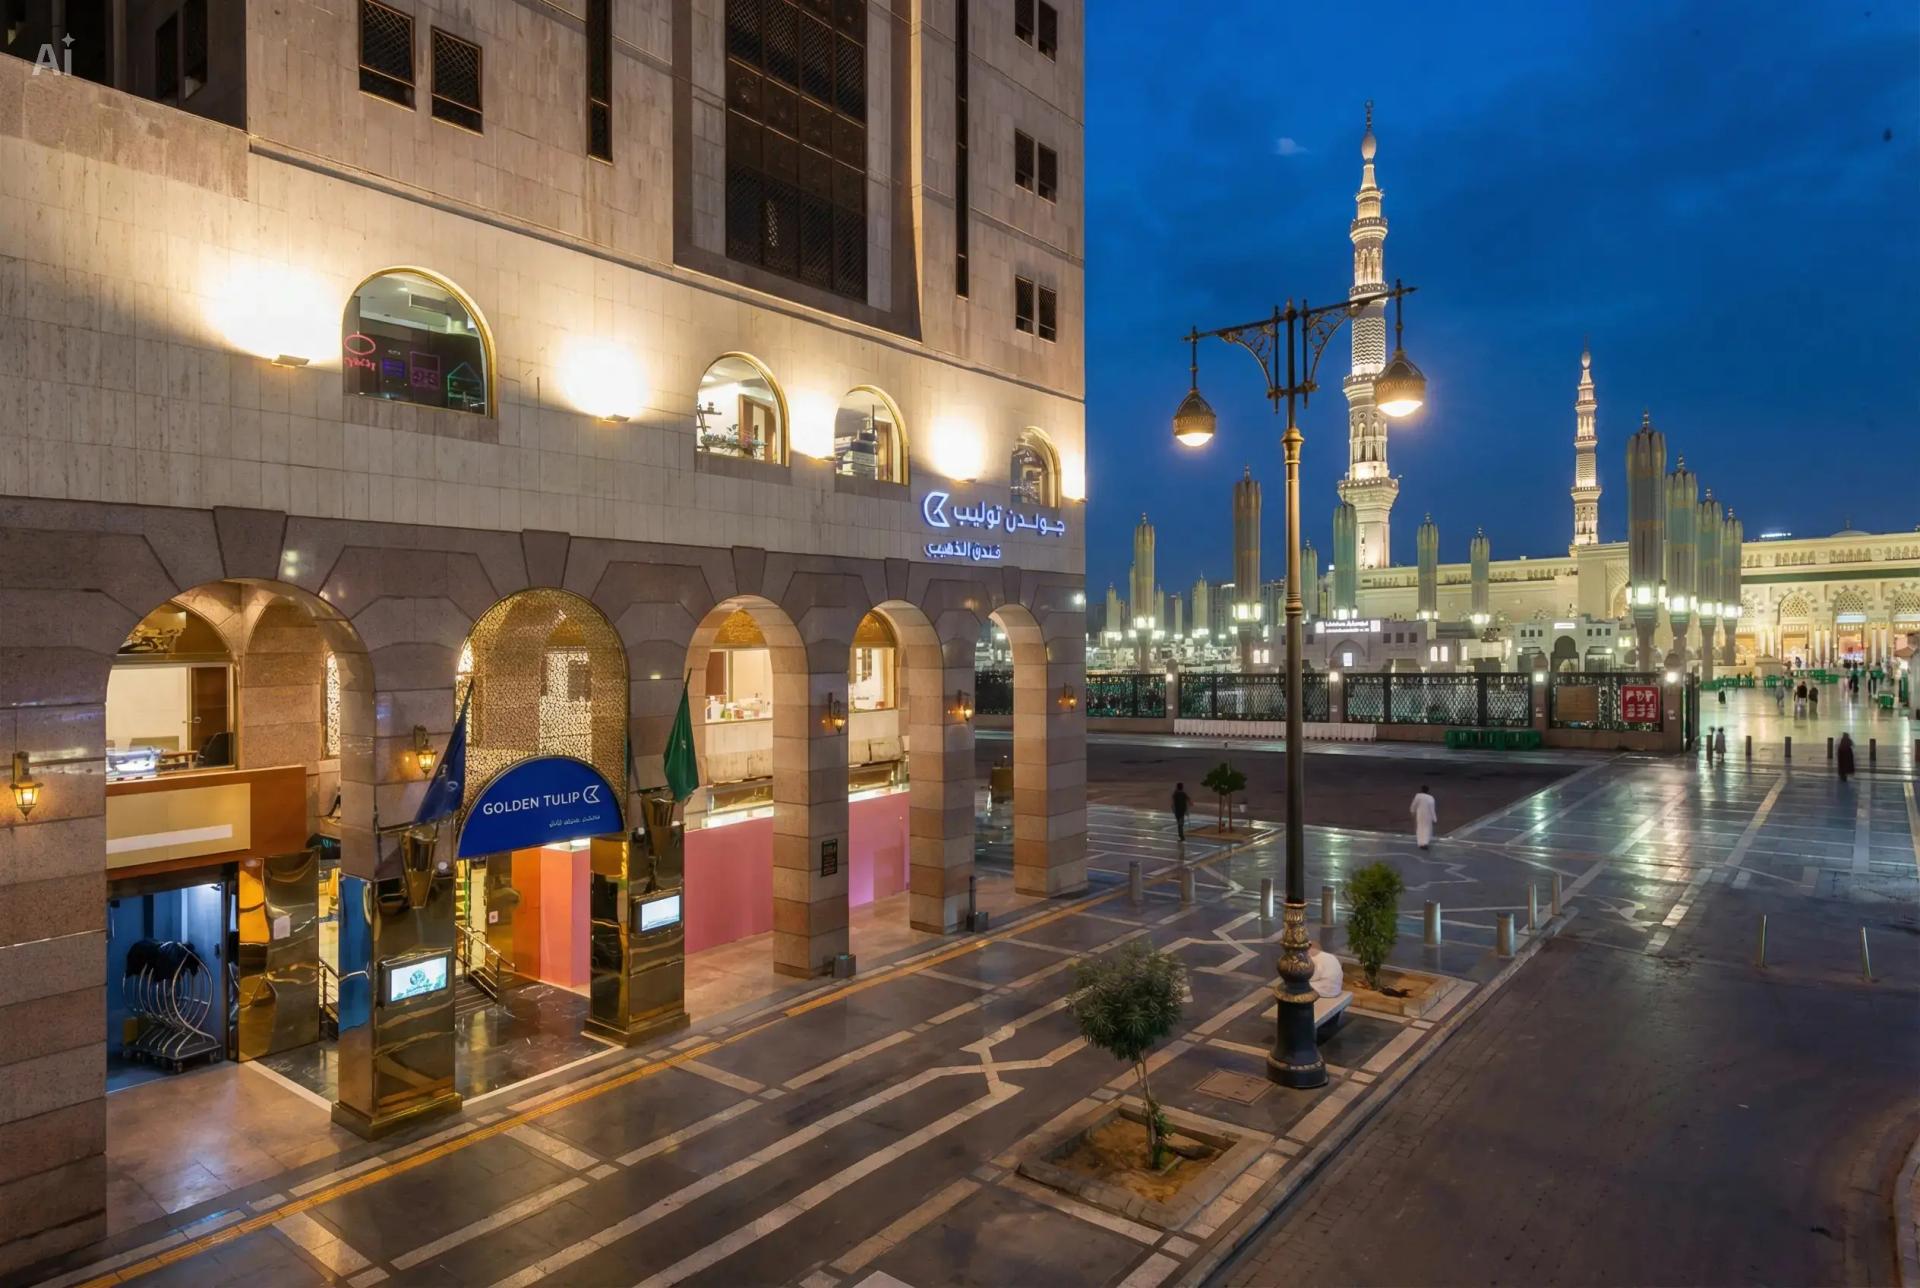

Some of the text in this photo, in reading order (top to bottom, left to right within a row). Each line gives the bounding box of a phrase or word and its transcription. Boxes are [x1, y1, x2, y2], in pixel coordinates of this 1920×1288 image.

[953, 501, 1003, 530] توليب
[971, 543, 1001, 561] فندق
[483, 791, 580, 815] GOLDEN TULIP
